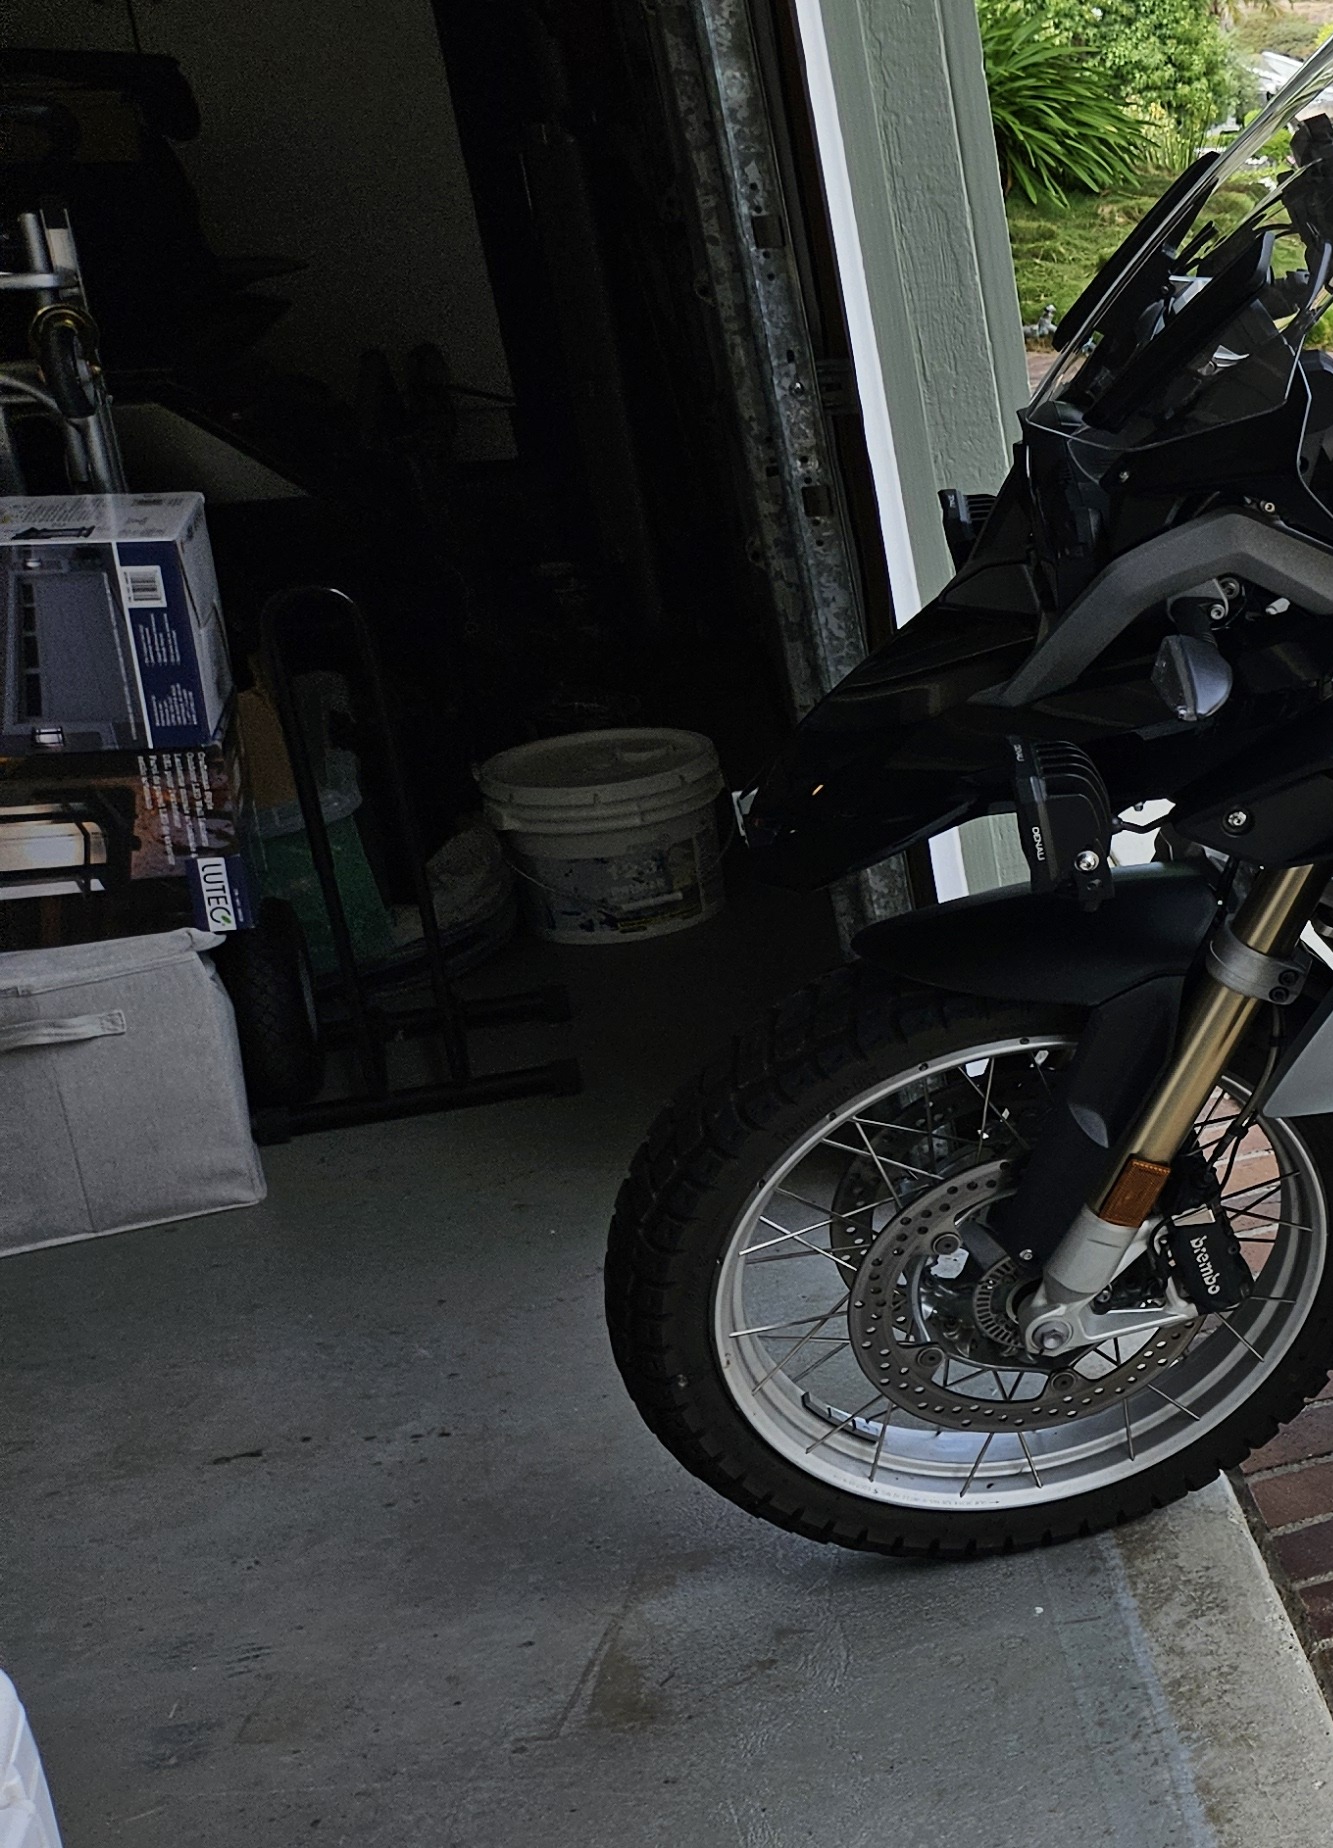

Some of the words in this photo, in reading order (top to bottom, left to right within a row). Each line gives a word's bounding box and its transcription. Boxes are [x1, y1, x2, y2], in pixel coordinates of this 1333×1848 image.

[1031, 825, 1046, 862] DENALI
[202, 863, 232, 924] LUTEC
[1190, 1235, 1219, 1294] brembo
